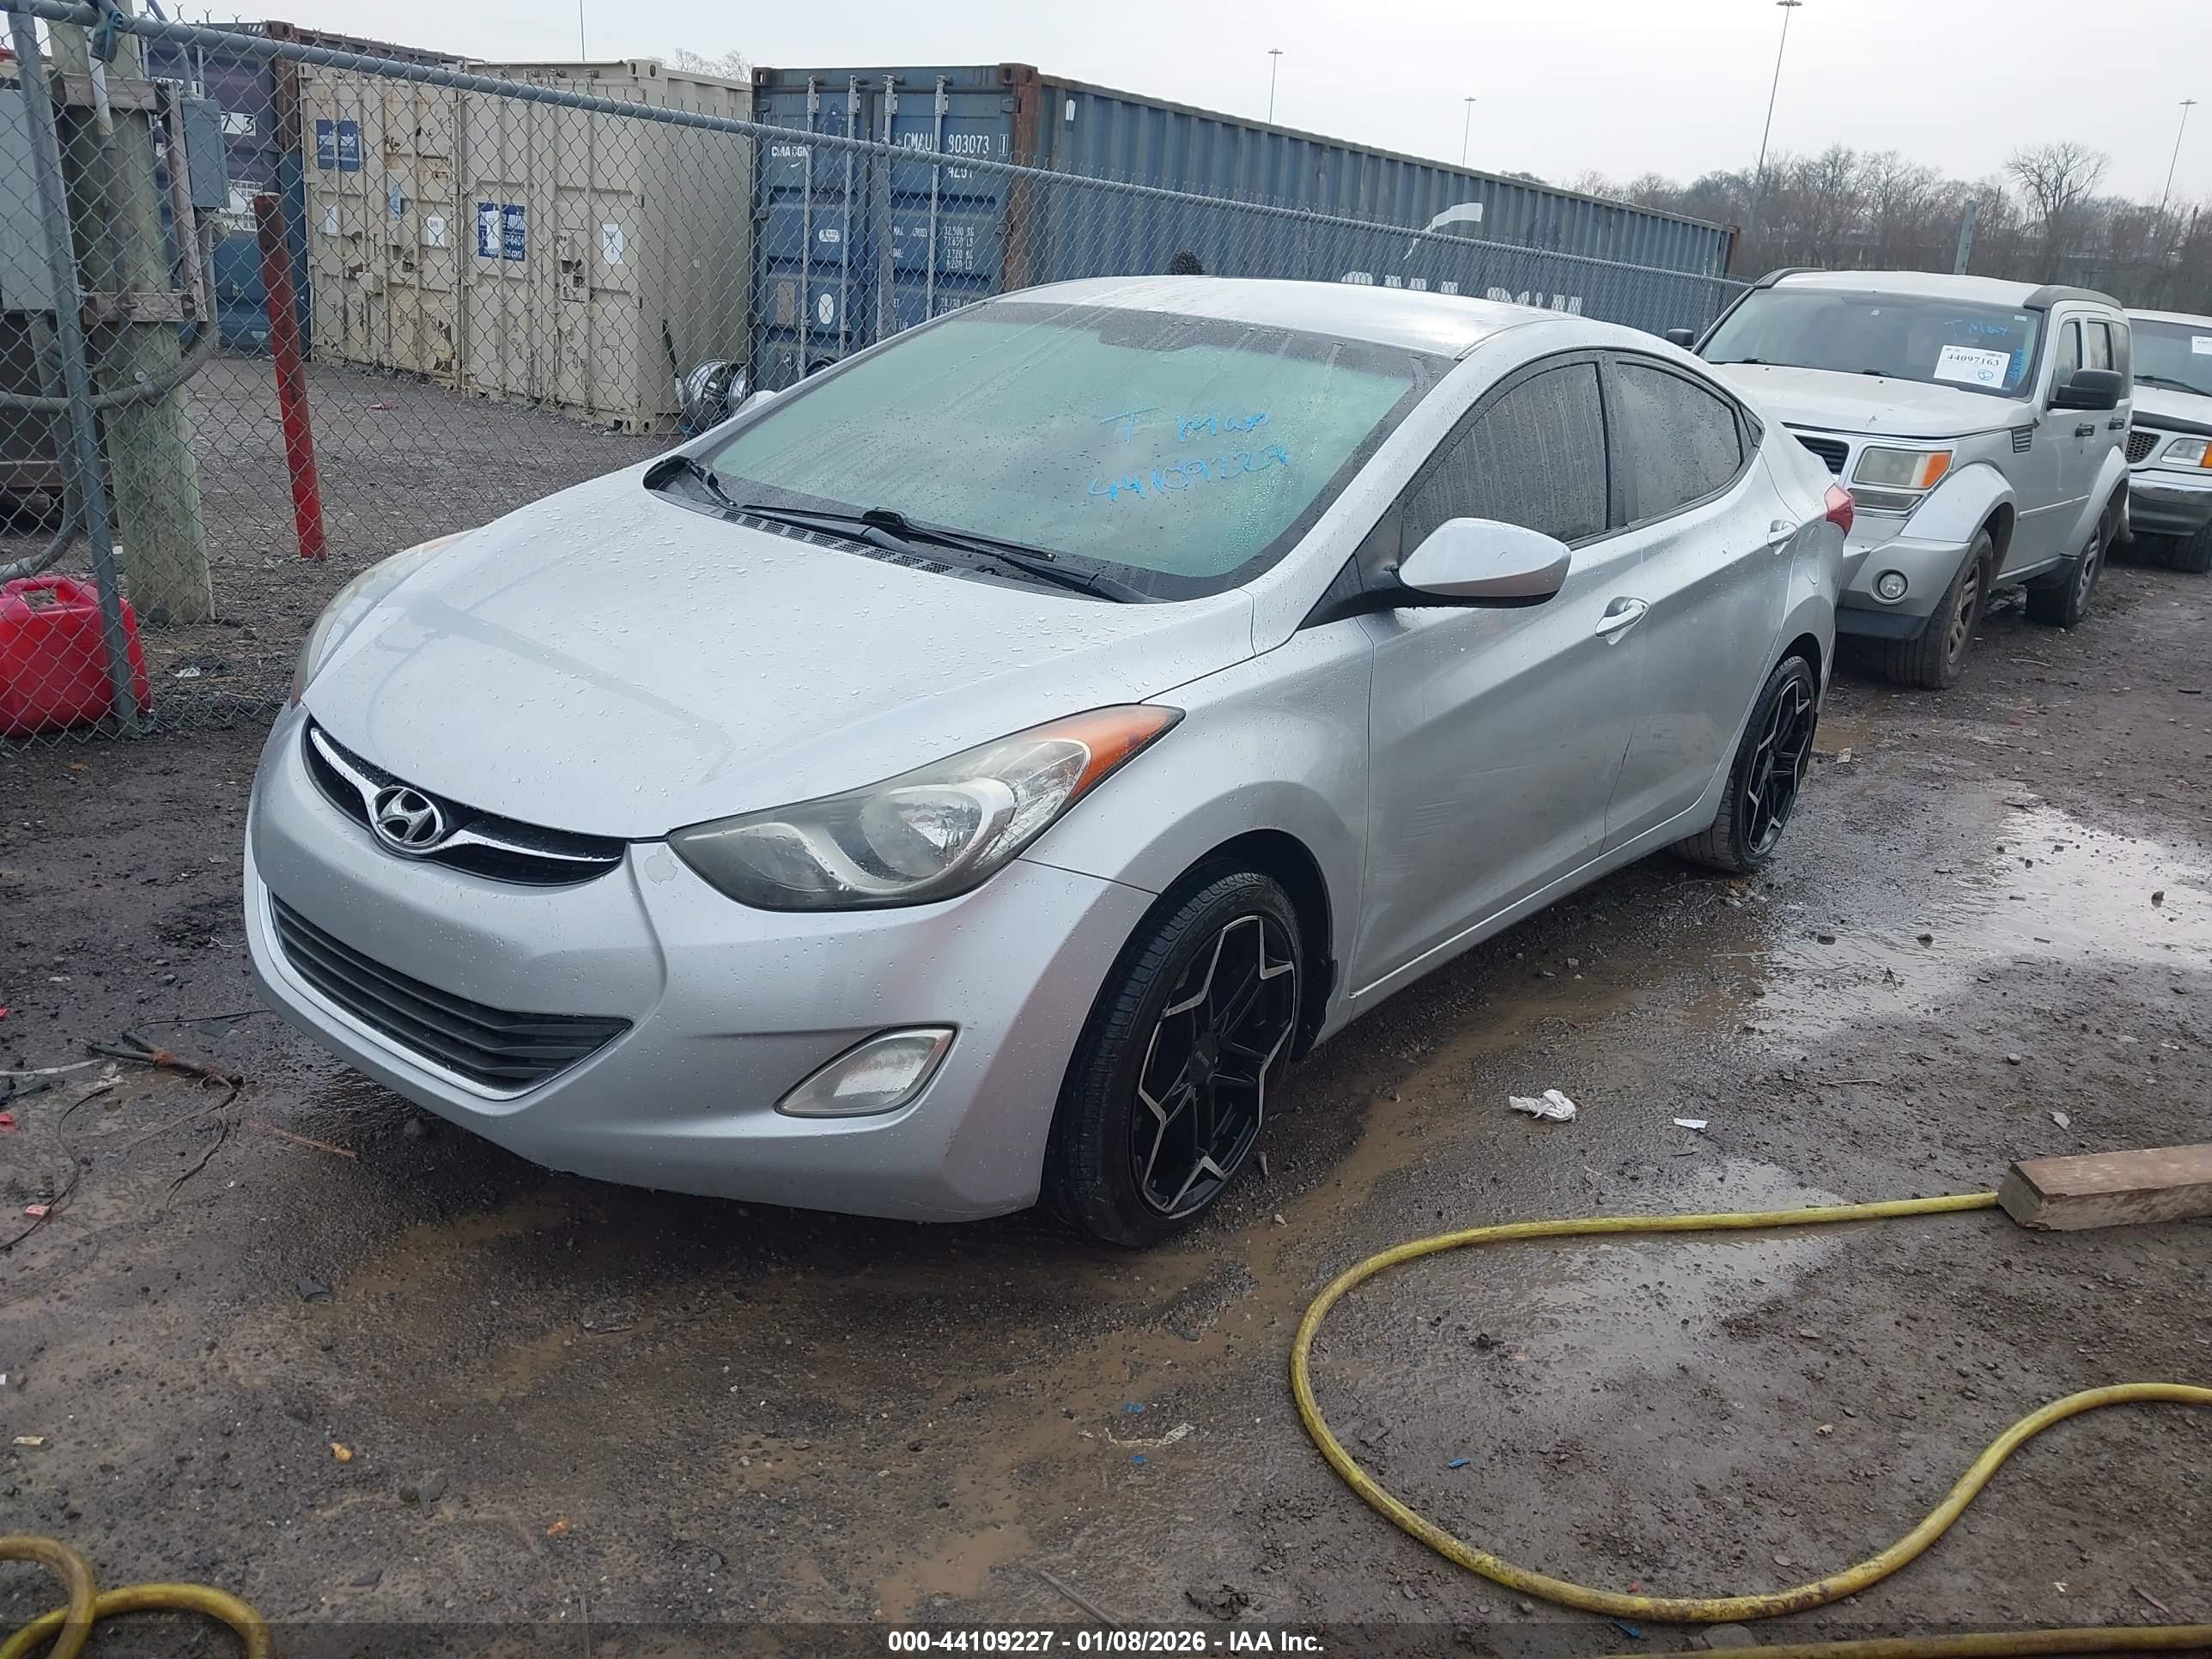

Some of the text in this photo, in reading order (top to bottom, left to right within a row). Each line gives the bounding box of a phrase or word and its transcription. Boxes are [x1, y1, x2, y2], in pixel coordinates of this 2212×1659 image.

[904, 132, 933, 152] CMAU
[1947, 353, 2000, 367] 44097163
[1088, 444, 1289, 502] 44109227
